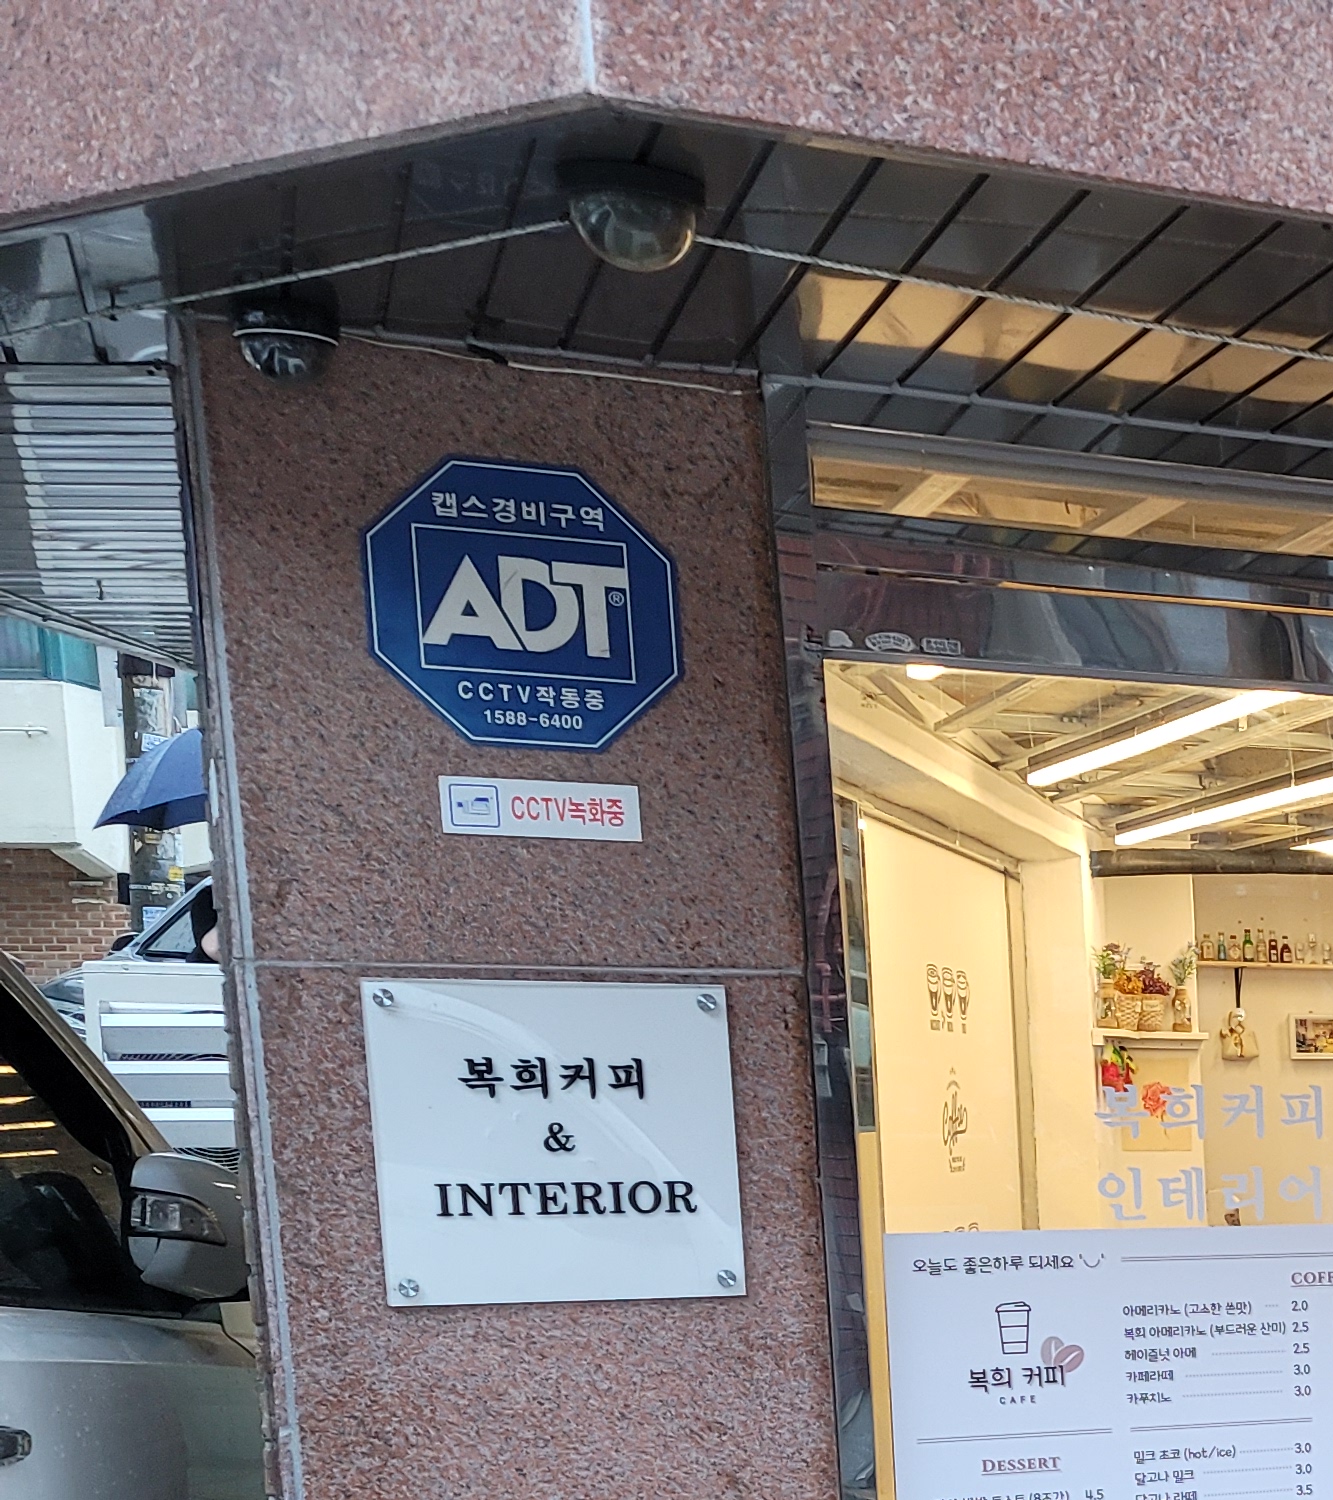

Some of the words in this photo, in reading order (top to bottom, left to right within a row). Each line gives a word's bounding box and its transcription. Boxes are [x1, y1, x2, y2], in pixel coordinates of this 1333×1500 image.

[432, 492, 604, 531] 캡스경비구역
[422, 554, 626, 659] ADT
[458, 680, 604, 711] CCTV작동중
[483, 709, 582, 730] 1588-6400
[511, 796, 625, 827] CCTV녹화중
[458, 1057, 645, 1099] 복희커피
[1095, 1084, 1324, 1140] 복희커피
[543, 1122, 576, 1152] &
[434, 1180, 697, 1217] INTERIOR
[913, 1259, 957, 1276] 오늘도
[963, 1256, 1024, 1274] 좋은하루
[1029, 1255, 1074, 1270] 되세요
[1123, 1303, 1181, 1317] 아메리카노
[1184, 1302, 1222, 1318] (고소한
[1291, 1300, 1309, 1312] 2.0
[1150, 1324, 1207, 1338] 아메리카노
[1209, 1322, 1257, 1338] (부드러운
[1260, 1321, 1287, 1336] 산미)
[1292, 1321, 1309, 1333] 2.5
[1124, 1348, 1170, 1363] 헤이즐넛
[1172, 1347, 1197, 1360] 아메
[1292, 1342, 1310, 1354] 2.5
[968, 1367, 1013, 1394] 복희
[1022, 1365, 1066, 1388] 커피
[1125, 1369, 1174, 1383] 카페라떼
[1293, 1363, 1311, 1376] 3.0
[999, 1395, 1037, 1405] CAFE
[1126, 1391, 1172, 1405] 카푸치노
[1294, 1385, 1311, 1397] 3.0
[982, 1456, 1061, 1473] DESSERT
[1133, 1450, 1156, 1465] 밀크
[1159, 1448, 1181, 1461] 초코
[1184, 1445, 1236, 1462] (hot/ice)
[1294, 1442, 1312, 1454] 3.0
[1134, 1471, 1169, 1486] 달고나
[1172, 1469, 1195, 1484] 밀크
[1295, 1463, 1312, 1475] 3.0
[1085, 1488, 1104, 1500] 4.5
[1296, 1484, 1313, 1496] 3.5
